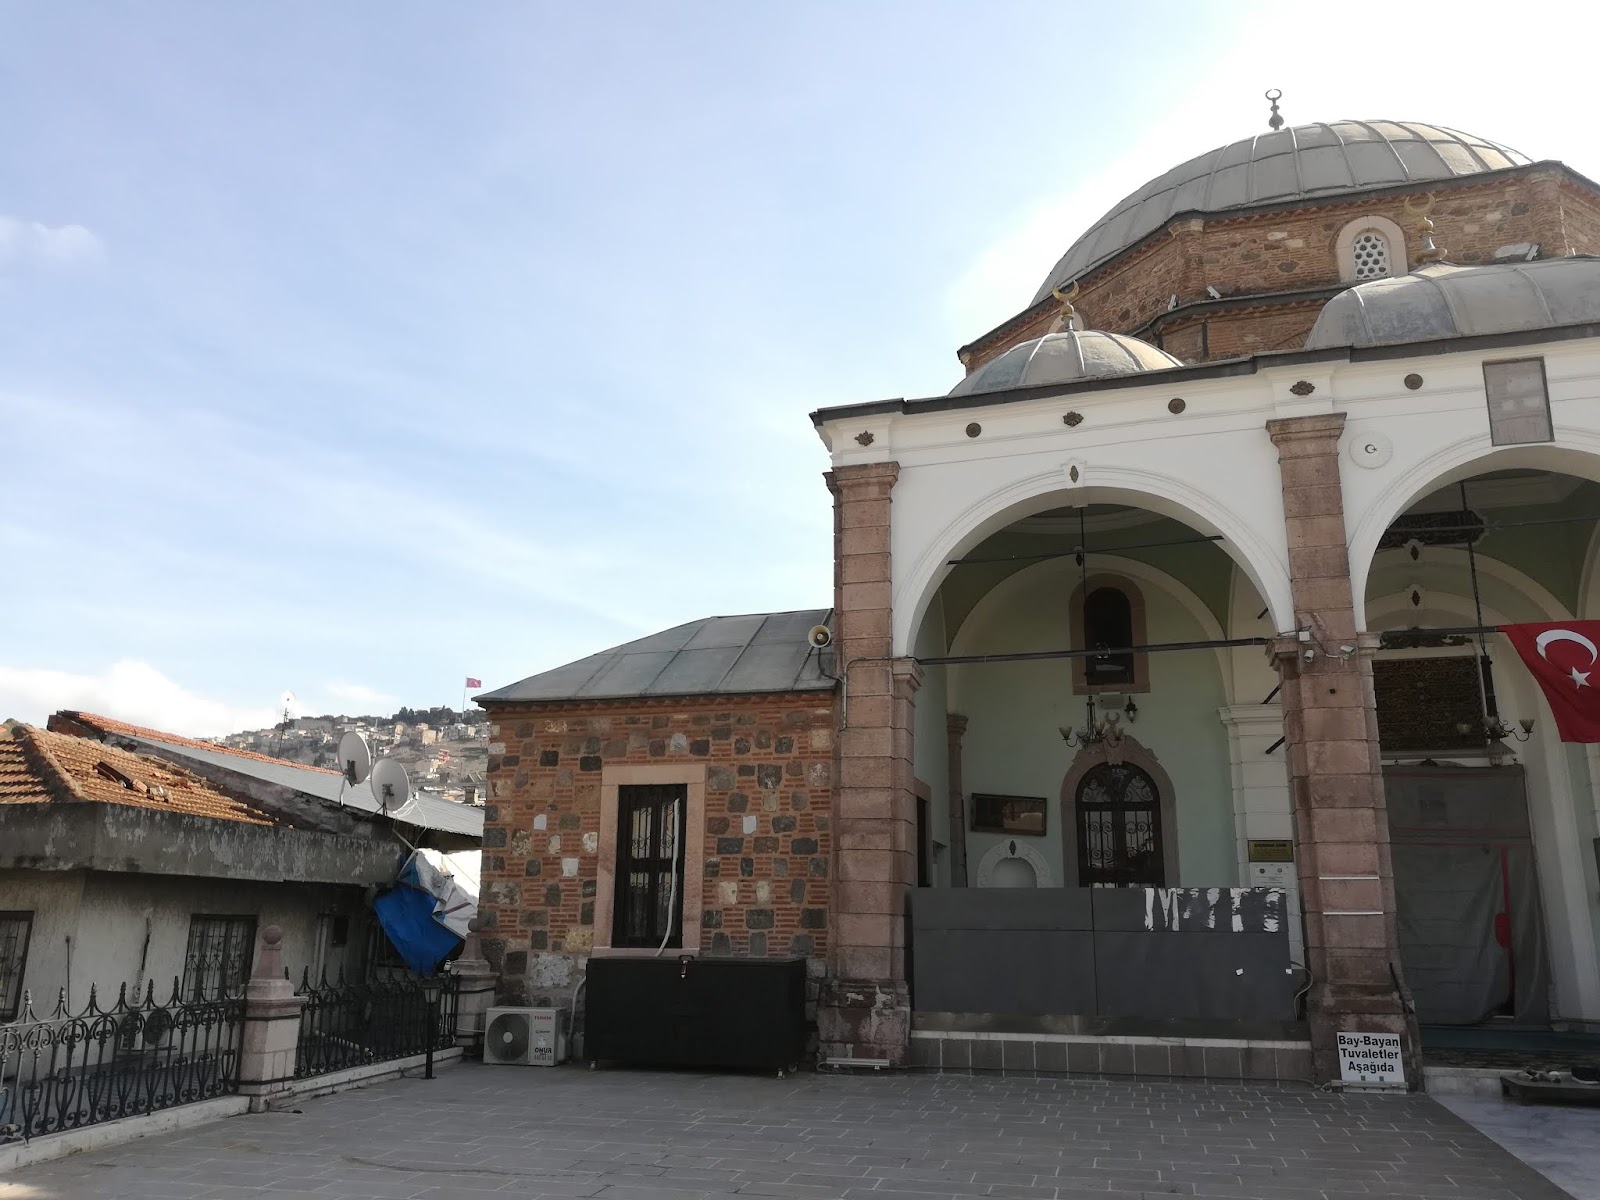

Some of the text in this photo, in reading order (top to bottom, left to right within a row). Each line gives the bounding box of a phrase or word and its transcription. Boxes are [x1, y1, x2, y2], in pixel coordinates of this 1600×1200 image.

[1338, 1035, 1399, 1048] Bay-Bayan
[1340, 1048, 1399, 1059] Tuvaletler
[1348, 1061, 1394, 1074] Aşağıda
